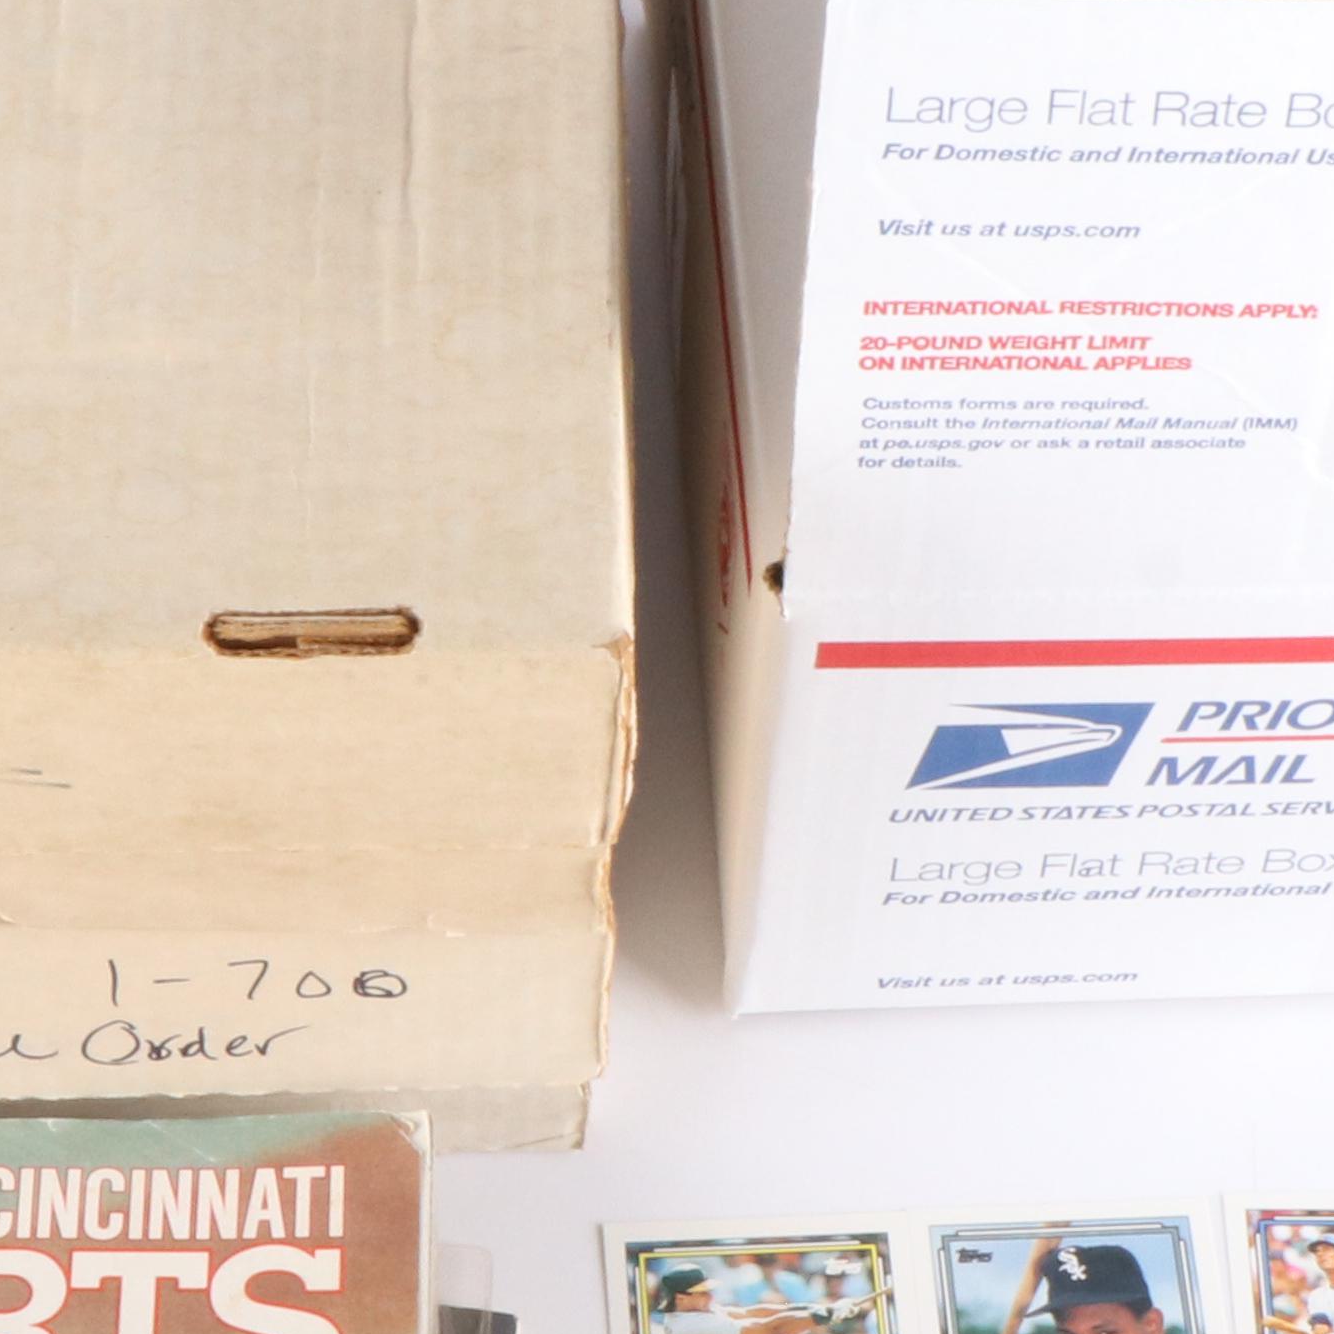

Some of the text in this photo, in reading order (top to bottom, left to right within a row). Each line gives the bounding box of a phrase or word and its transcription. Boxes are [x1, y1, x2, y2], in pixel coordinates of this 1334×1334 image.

[885, 87, 1029, 133] Large
[1047, 89, 1134, 128] Flat
[1153, 90, 1267, 129] Rate
[882, 142, 927, 161] For
[935, 142, 1061, 164] Domestic
[1068, 144, 1121, 164] and
[1127, 145, 1298, 166] International
[877, 219, 1140, 241] Visit us at usps.com
[863, 300, 1318, 319] INTERNATIONAL RESTRICTIONS APPLY:
[860, 335, 1152, 352] 20-POUND WEIGHT LIMIT
[859, 356, 1192, 371] ON INTERNATIONAL APPLIES
[863, 396, 1149, 415] Customs forms are required.
[861, 416, 1298, 433] Consult the International Mail Manual (IMM)
[858, 436, 1246, 454] at pe.usps.gov or ask retail associate
[857, 455, 963, 469] for details.
[1144, 753, 1316, 787] MAIL
[888, 807, 1013, 824] UNITED
[1017, 803, 1131, 821] STATES
[1137, 802, 1259, 819] POSTAL
[889, 856, 1023, 887] Large
[1041, 853, 1121, 879] Flat
[1138, 850, 1245, 876] Rate
[882, 891, 927, 906] For
[939, 887, 1076, 904] Domestic
[1084, 885, 1138, 901] and
[1146, 882, 1331, 900] International
[877, 971, 1138, 989] Visit us at usps.com
[83, 1019, 312, 1066] Order
